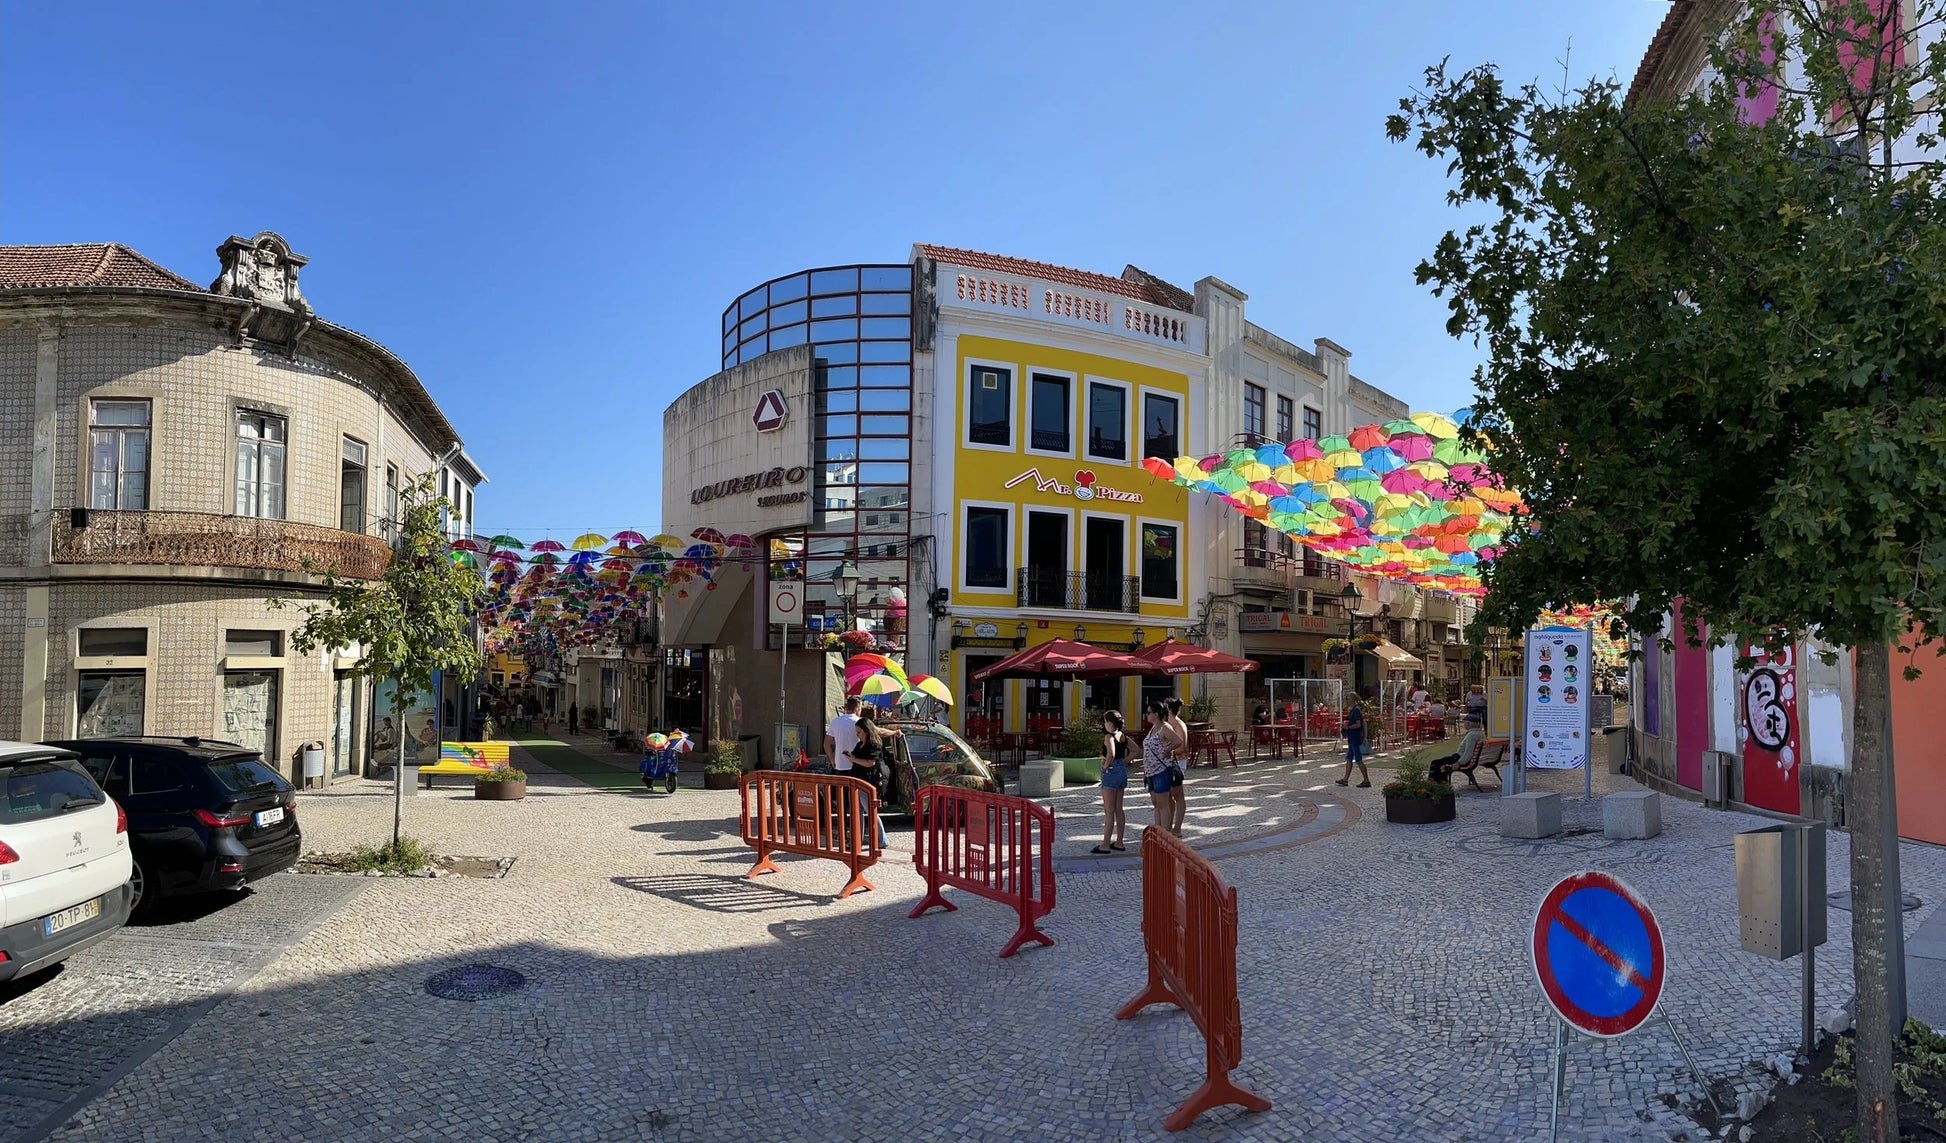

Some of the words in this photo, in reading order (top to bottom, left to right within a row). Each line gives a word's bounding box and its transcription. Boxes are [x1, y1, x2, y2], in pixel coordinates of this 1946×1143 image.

[691, 466, 806, 504] LOUREIRO
[1095, 486, 1144, 503] Pizza
[1246, 614, 1271, 623] TRIGAL
[1300, 616, 1328, 629] TRIGAL
[66, 847, 89, 857] PEUGEOT
